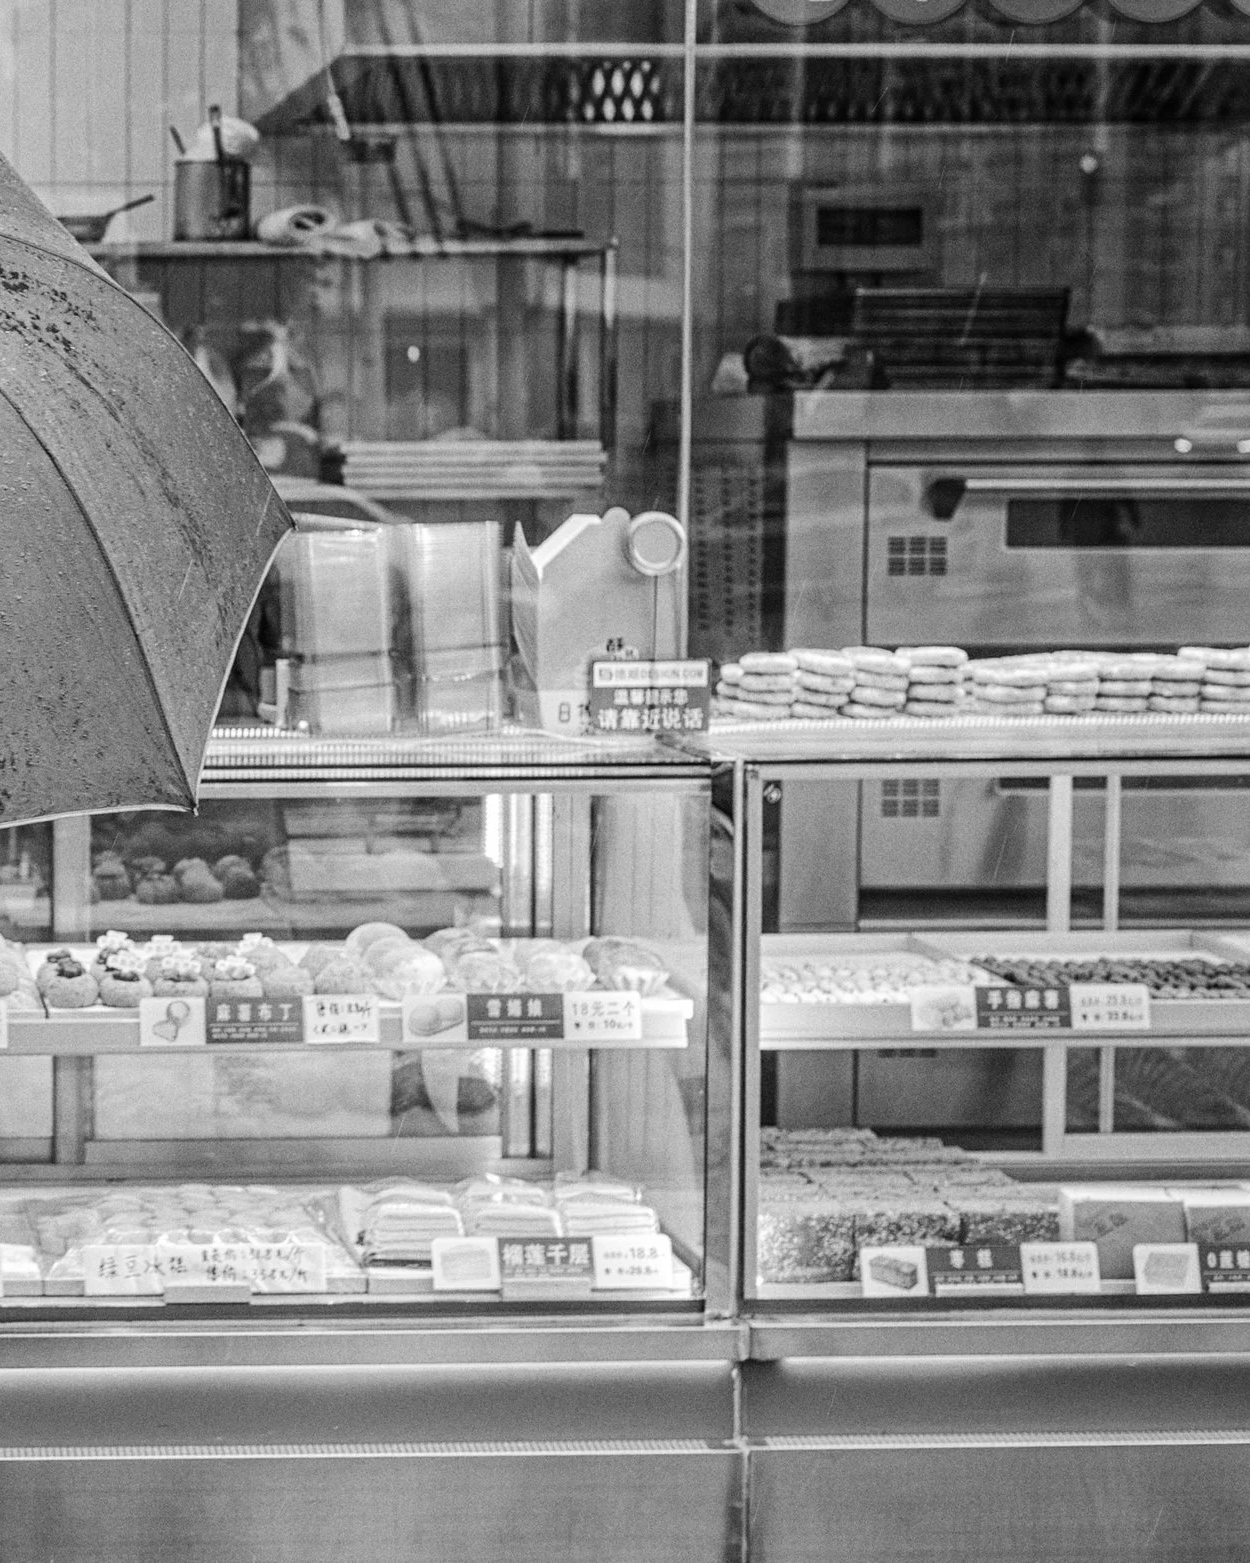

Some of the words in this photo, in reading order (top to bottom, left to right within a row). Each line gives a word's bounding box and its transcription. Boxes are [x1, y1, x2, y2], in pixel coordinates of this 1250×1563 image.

[598, 708, 703, 730] 请靠近说话
[571, 1000, 635, 1017] 18元二个
[503, 1243, 591, 1265] 榴莲千层
